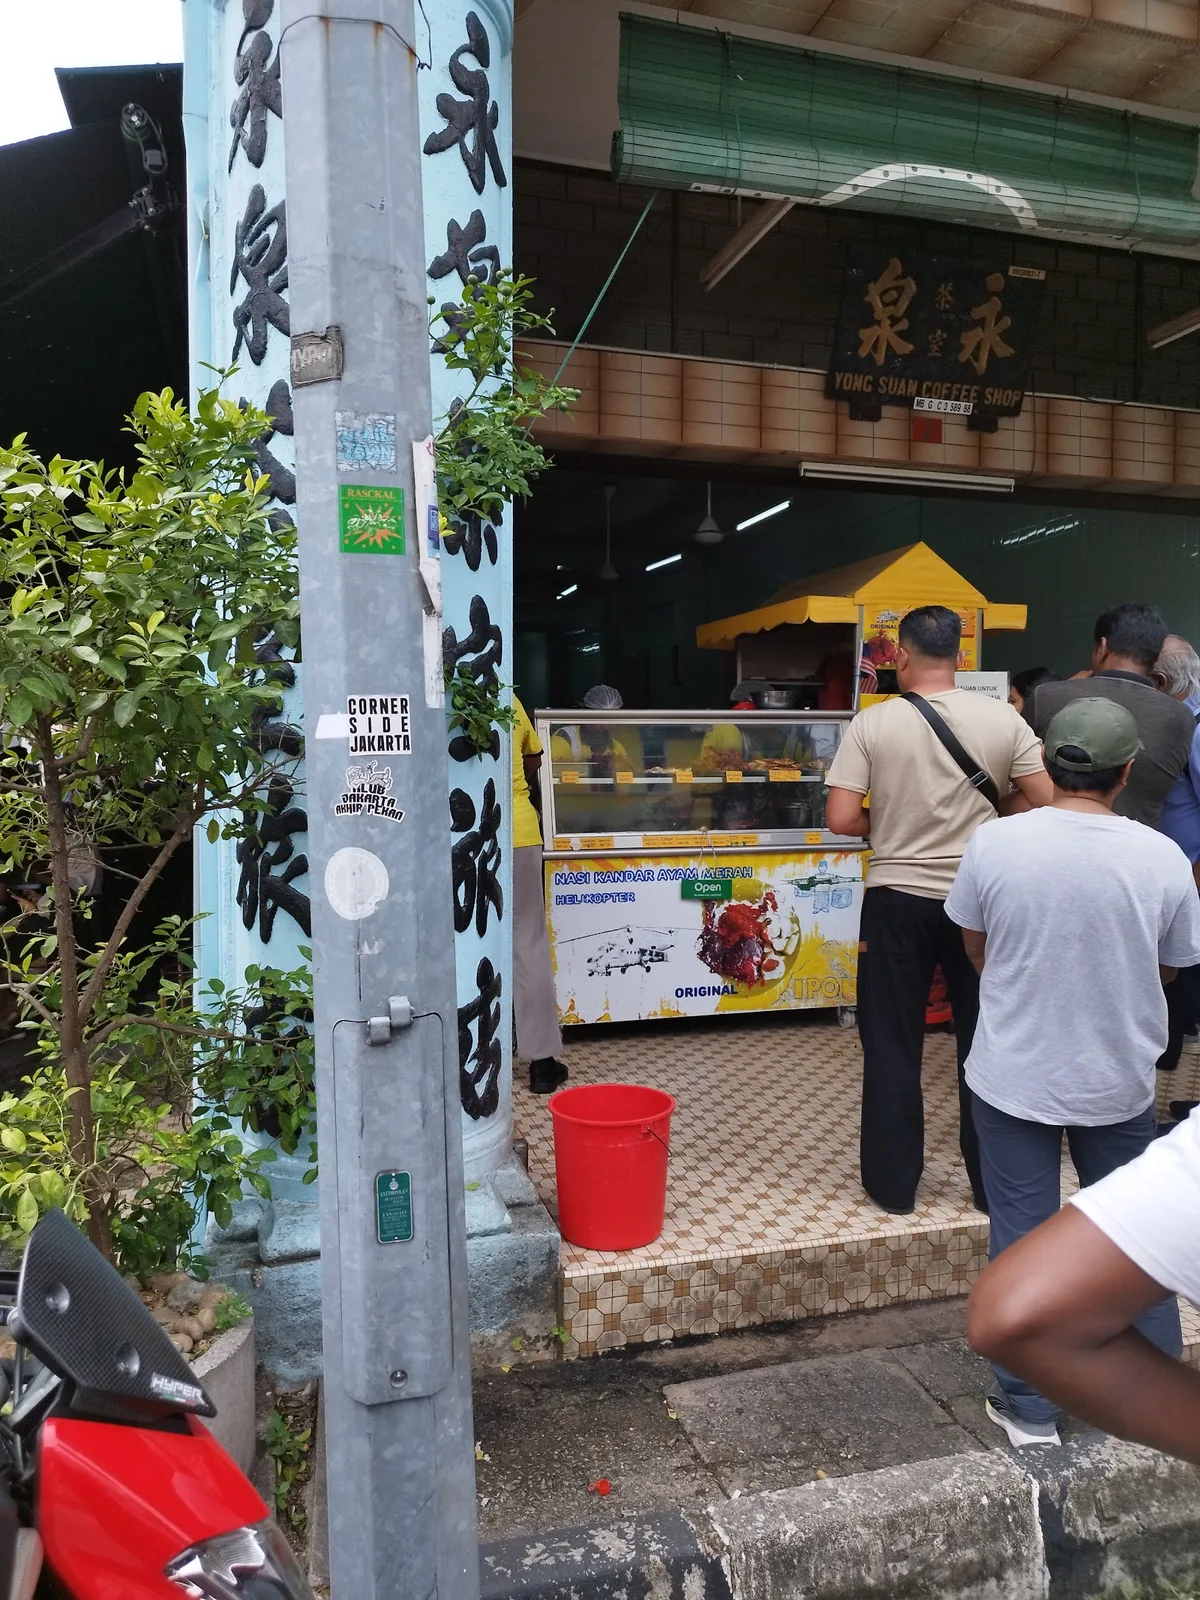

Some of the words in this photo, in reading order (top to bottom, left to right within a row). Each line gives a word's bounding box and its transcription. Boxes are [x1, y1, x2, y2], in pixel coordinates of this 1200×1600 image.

[835, 372, 873, 393] YONG
[878, 376, 917, 398] SUAN
[921, 380, 980, 402] COFFEE
[984, 387, 1022, 407] SHOP
[915, 398, 925, 408] MB
[347, 488, 395, 499] RASCKAL
[348, 698, 409, 715] CORNER
[349, 716, 409, 733] SIDE
[350, 734, 410, 752] JAKARTA
[341, 793, 396, 808] JAKARTA
[336, 803, 363, 815] AKHIR
[367, 802, 404, 821] PEKAN
[555, 871, 590, 886] NASI
[594, 869, 654, 884] KANDAR
[657, 868, 698, 881] AYAM
[700, 866, 753, 880] MERAH
[694, 882, 722, 893] Open
[555, 892, 636, 906] HELIKOPTER
[674, 984, 738, 999] ORIGINAL
[151, 1377, 204, 1404] HYPER
